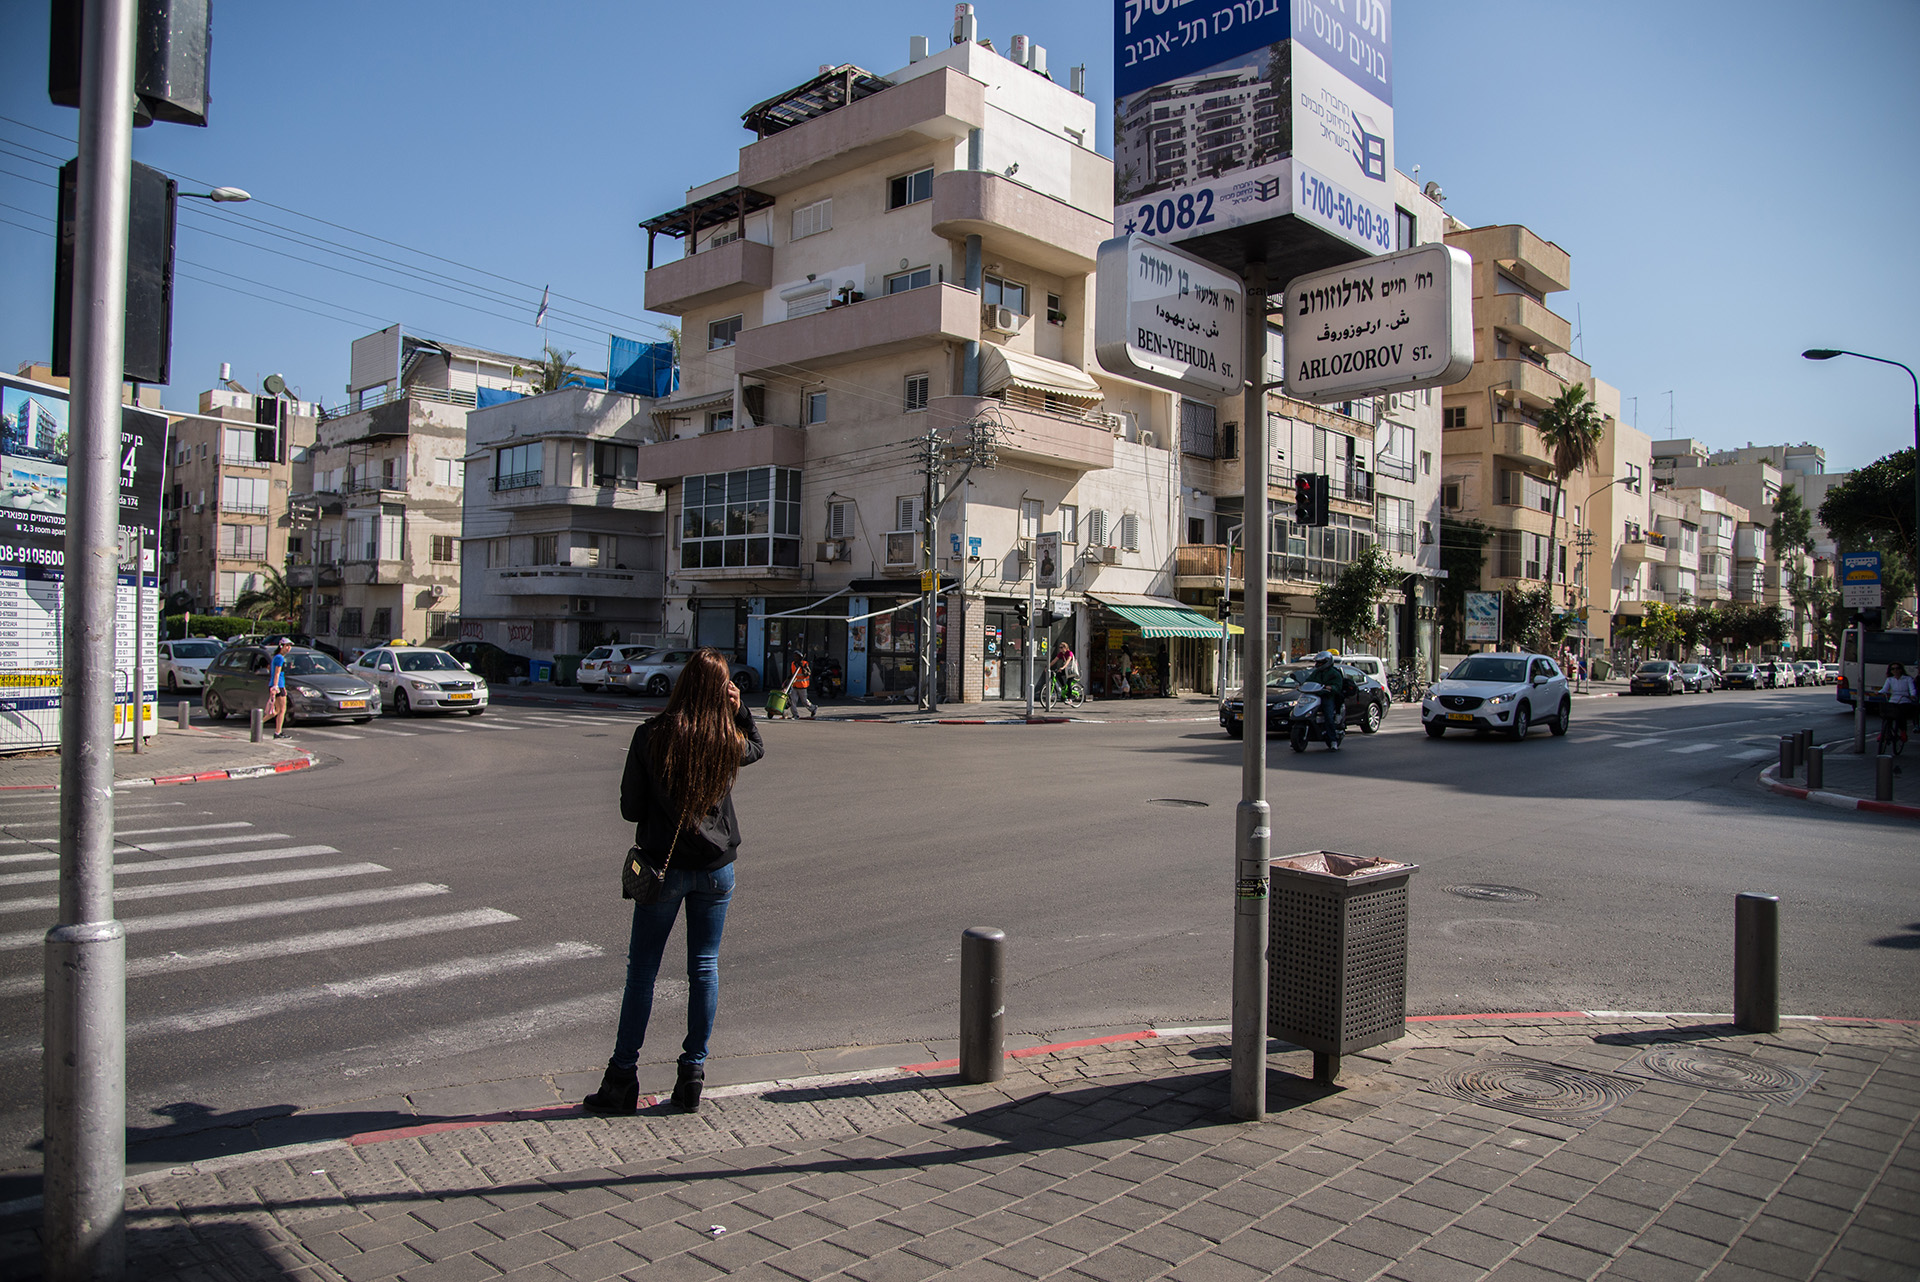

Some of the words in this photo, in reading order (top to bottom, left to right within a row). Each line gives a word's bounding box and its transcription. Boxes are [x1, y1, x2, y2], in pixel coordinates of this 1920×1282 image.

[1212, 0, 1279, 35] במרכז
[1124, 17, 1208, 68] תל-אביב
[1349, 31, 1387, 84] בונים
[1301, 92, 1325, 118] מבנים
[1321, 87, 1350, 118] החברה
[1319, 121, 1351, 153] בישראל
[1300, 171, 1390, 250] 1-700-50-60-38
[1140, 252, 1173, 288] יהודה
[1178, 268, 1189, 300] בן
[1194, 282, 1219, 308] אליעזר
[1298, 276, 1374, 316] ארלוזורוב
[1381, 276, 1407, 298] חיים
[1155, 304, 1185, 330] يهودا
[1187, 317, 1201, 335] بن
[1137, 327, 1217, 373] BEN-YEHUDA
[1221, 362, 1234, 379] ST.
[1298, 343, 1403, 381] ARLOZOROV
[1412, 345, 1432, 361] ST.
[133, 435, 144, 448] בן
[127, 498, 139, 507] 174
[30, 513, 67, 525] פנטהאוזים
[35, 526, 51, 534] room
